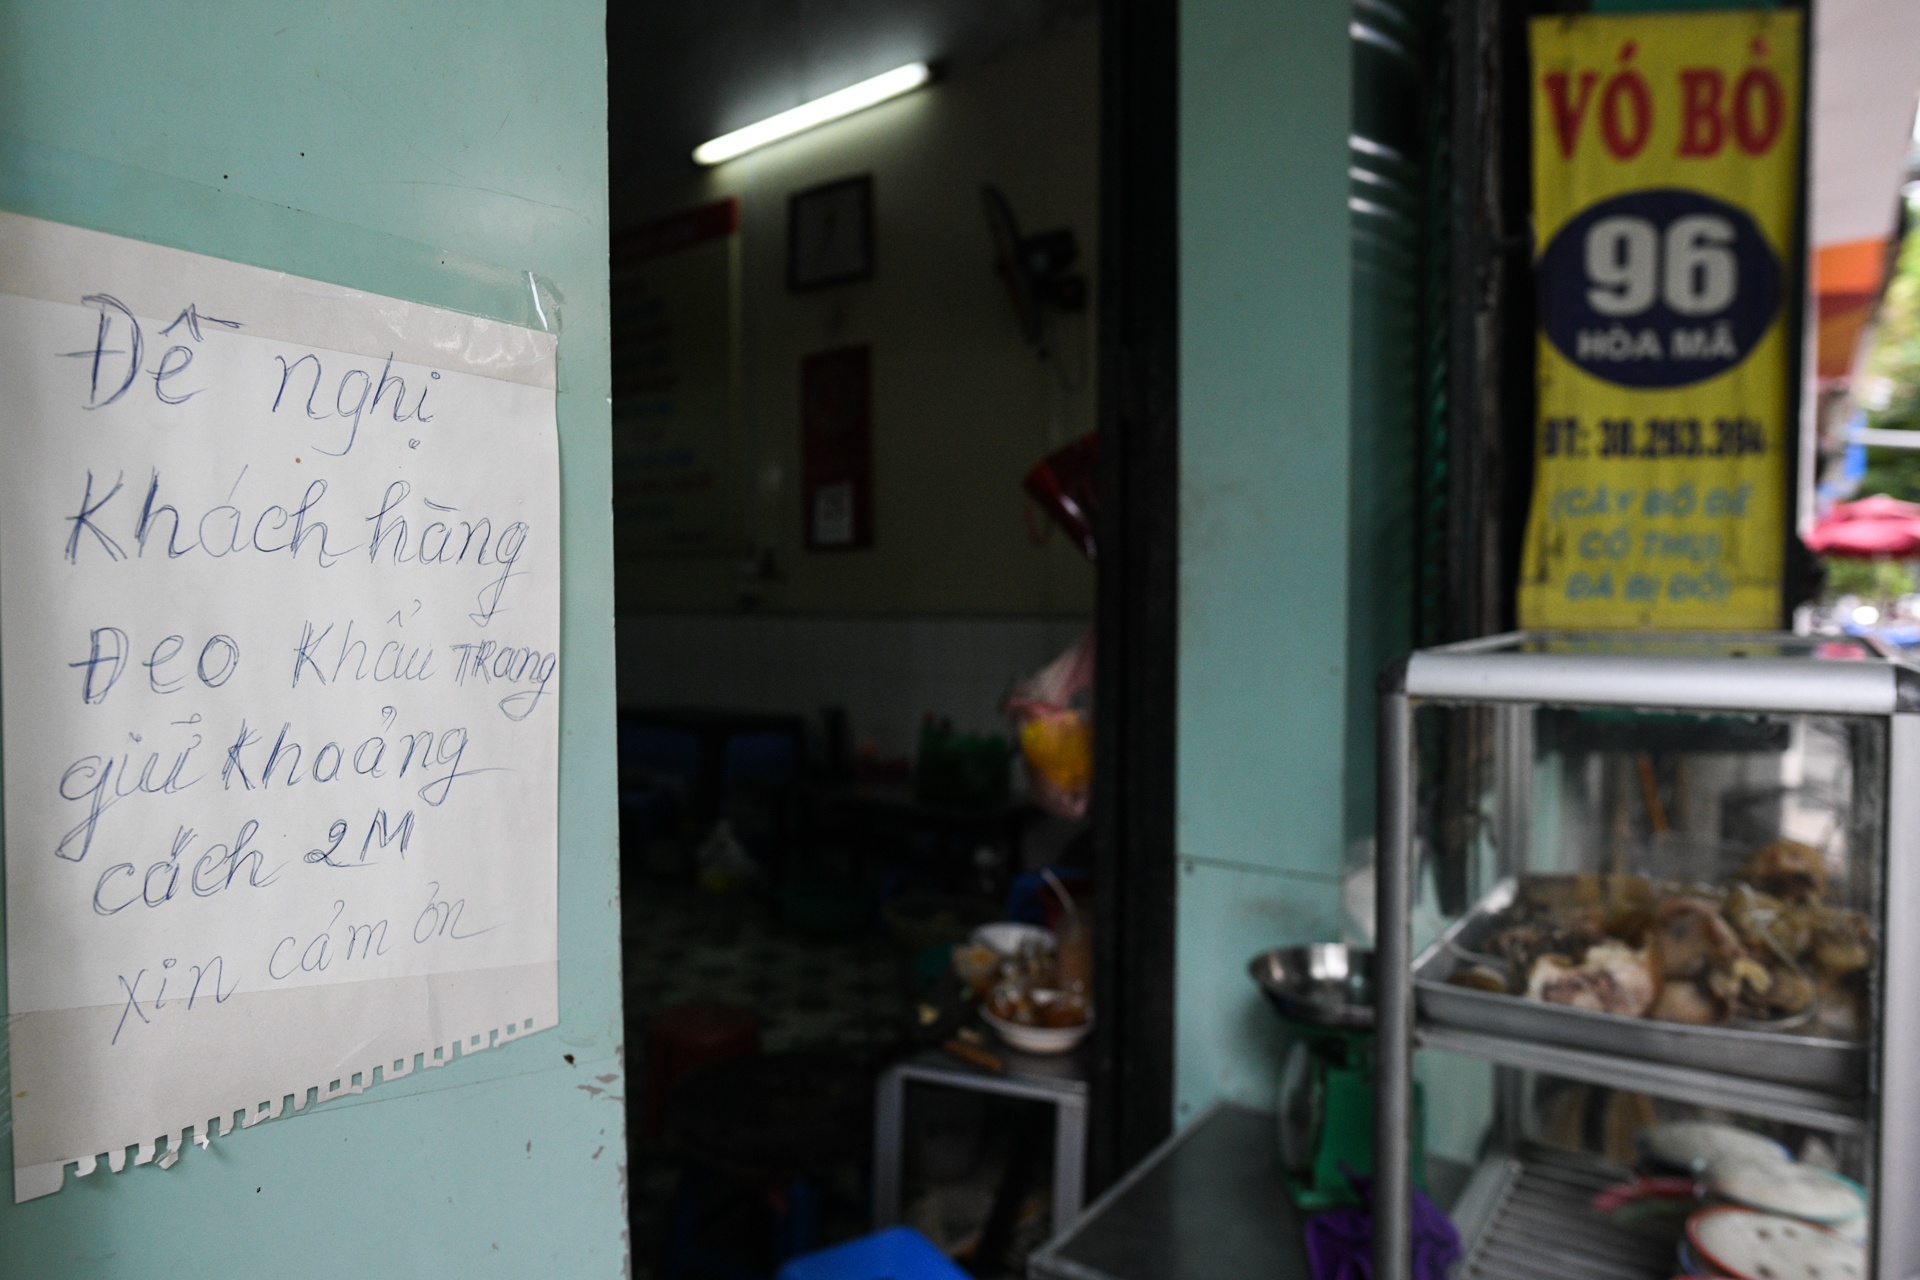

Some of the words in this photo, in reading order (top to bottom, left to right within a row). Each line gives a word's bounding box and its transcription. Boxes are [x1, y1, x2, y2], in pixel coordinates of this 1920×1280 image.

[1541, 39, 1654, 162] VÓ
[1584, 214, 1737, 316] 96
[1577, 324, 1662, 360] HÒA
[272, 351, 441, 455] nghị
[365, 480, 532, 627] hàng
[68, 626, 241, 704] Đeo
